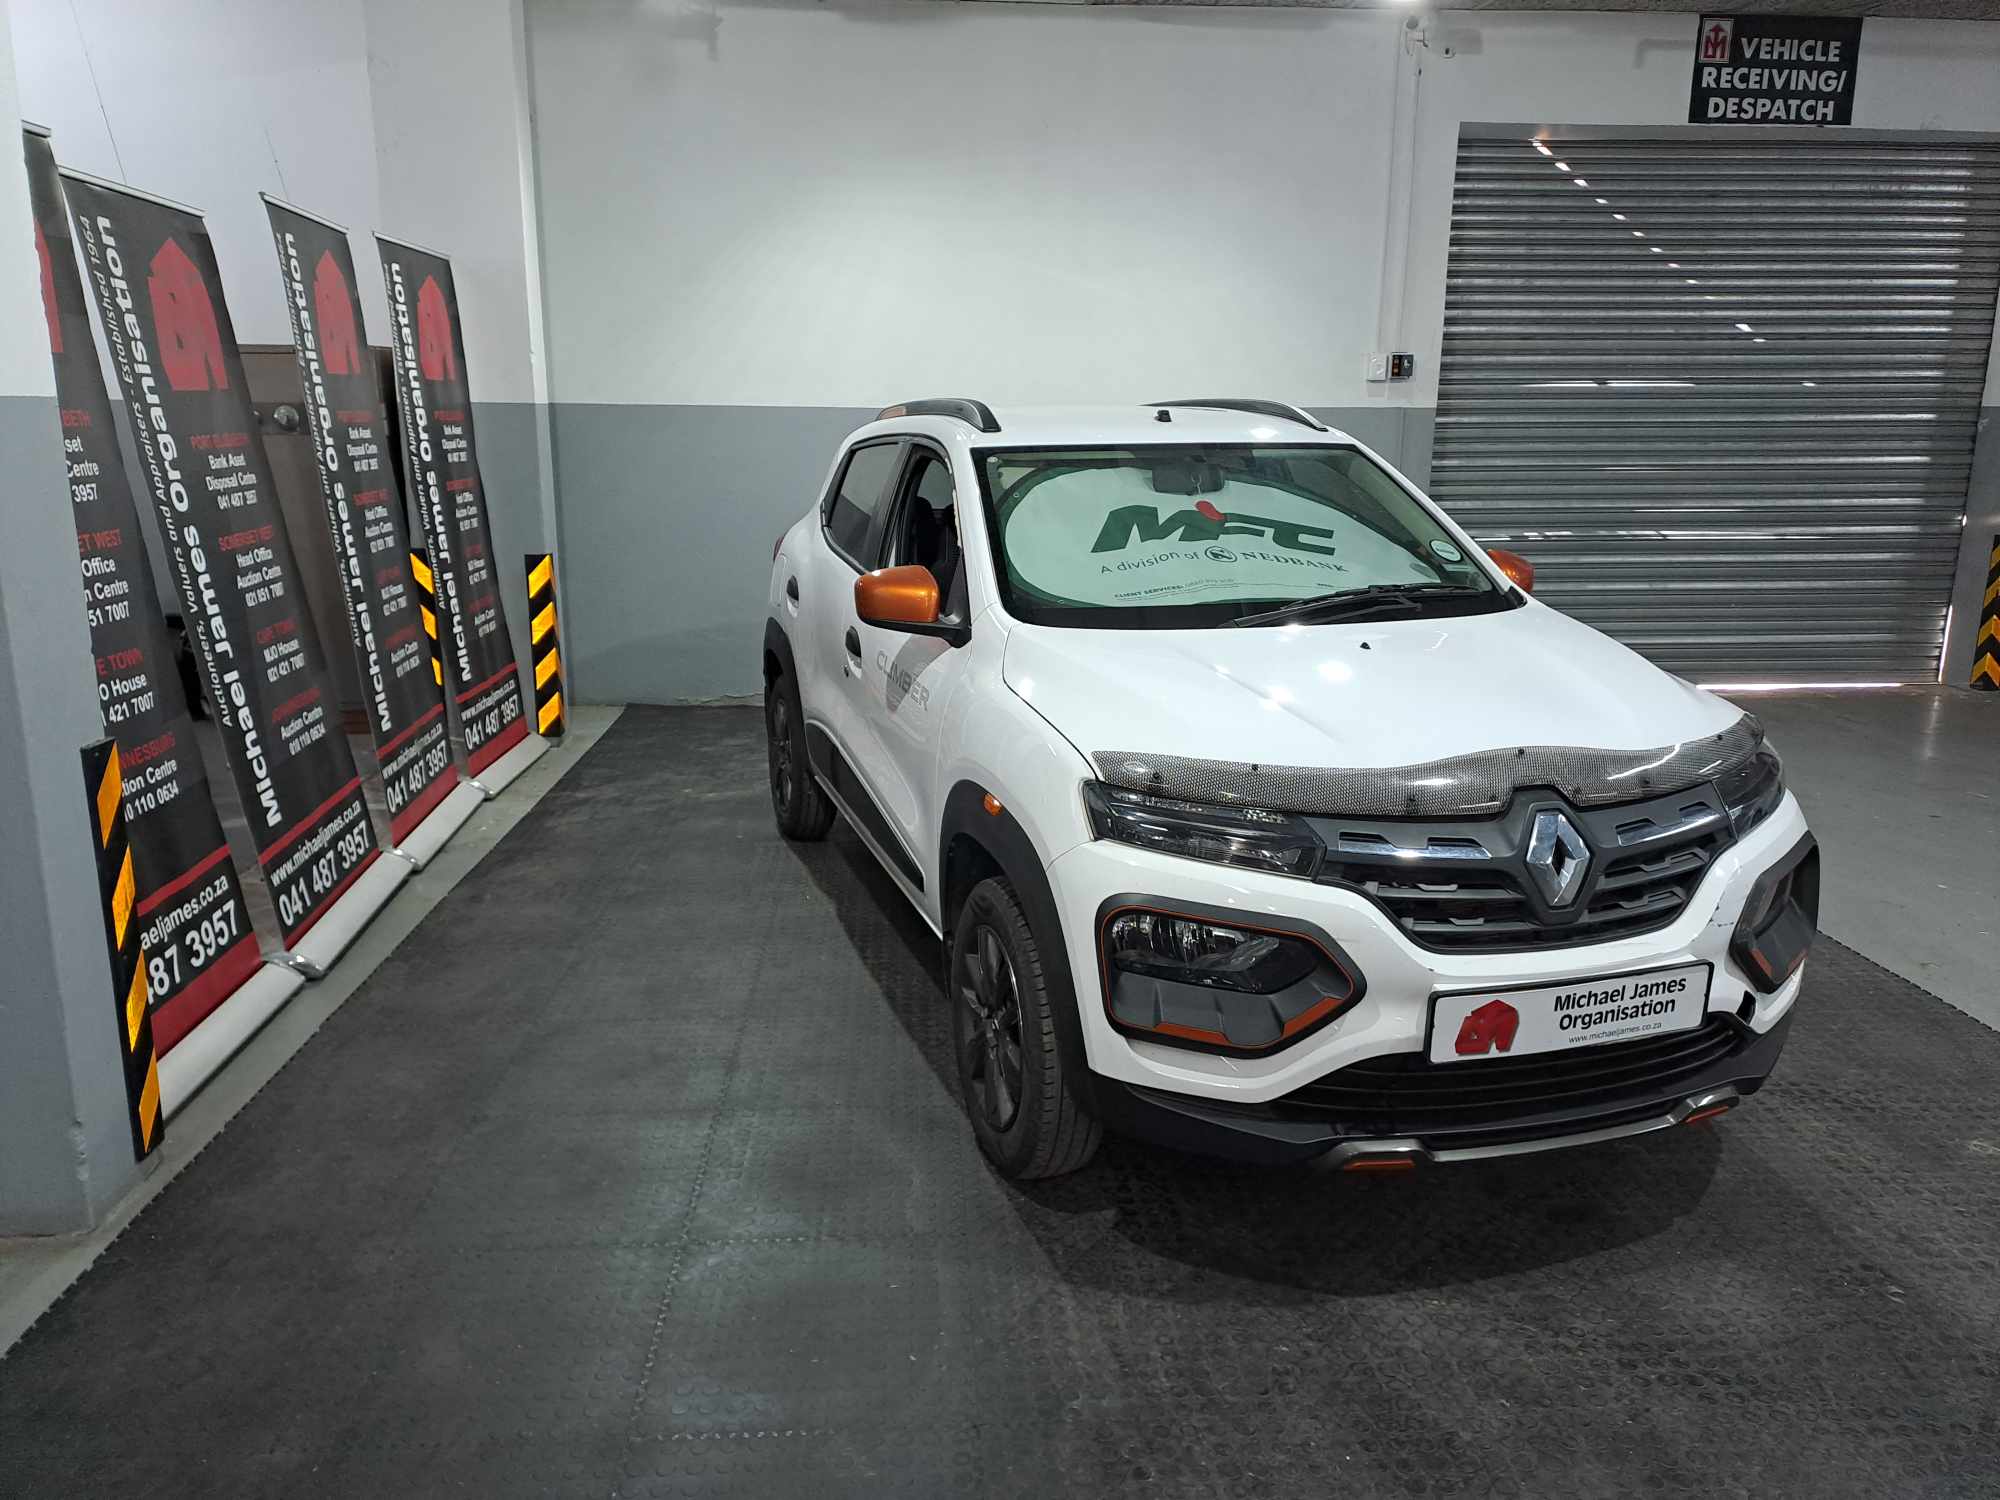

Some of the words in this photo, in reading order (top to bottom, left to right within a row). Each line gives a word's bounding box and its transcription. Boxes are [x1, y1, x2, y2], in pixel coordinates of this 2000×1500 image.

[1701, 66, 1848, 93] RECEIVING/
[1741, 37, 1842, 62] VEHICLE
[1707, 96, 1835, 121] DESPATCH
[79, 215, 101, 265] 1964
[94, 270, 134, 384] Established
[285, 232, 338, 472] Organisation
[96, 215, 189, 513] Organisation
[391, 262, 433, 462] Organisation
[132, 401, 167, 501] Appraisers
[71, 483, 98, 503] 3957
[159, 505, 178, 542] and
[426, 470, 450, 564] James
[81, 557, 116, 577] Office
[334, 482, 364, 593] James
[1100, 564, 1113, 575] A
[1117, 551, 1182, 571] division
[1184, 550, 1201, 561] of
[1240, 551, 1349, 573] NEDBANK
[94, 579, 129, 600] Centre
[105, 600, 130, 622] 7007
[174, 546, 199, 614] Valuers
[183, 525, 234, 659] James
[443, 572, 472, 682] Michael
[110, 673, 147, 697] House
[196, 620, 233, 727] Auctioneers,
[356, 602, 392, 732] Michael
[876, 649, 930, 711] CLIMBER
[109, 701, 129, 723] 421
[131, 691, 154, 715] 7007
[464, 721, 484, 750] 041
[485, 708, 500, 736] 487
[501, 694, 519, 724] 3957
[145, 759, 177, 784] Centre
[223, 670, 282, 827] Michael
[386, 776, 408, 813] 041
[409, 760, 426, 793] 487
[426, 739, 448, 777] 3957
[134, 793, 156, 814] 110
[156, 779, 179, 804] 0634
[270, 799, 362, 887] www.michaeljames.co.za
[278, 876, 312, 926] 041
[311, 850, 339, 895] 487
[337, 820, 370, 870] 3957
[185, 899, 238, 968] 3957
[1553, 984, 1626, 1012] Michael
[1630, 977, 1687, 1001] James
[1559, 997, 1676, 1032] Organisation
